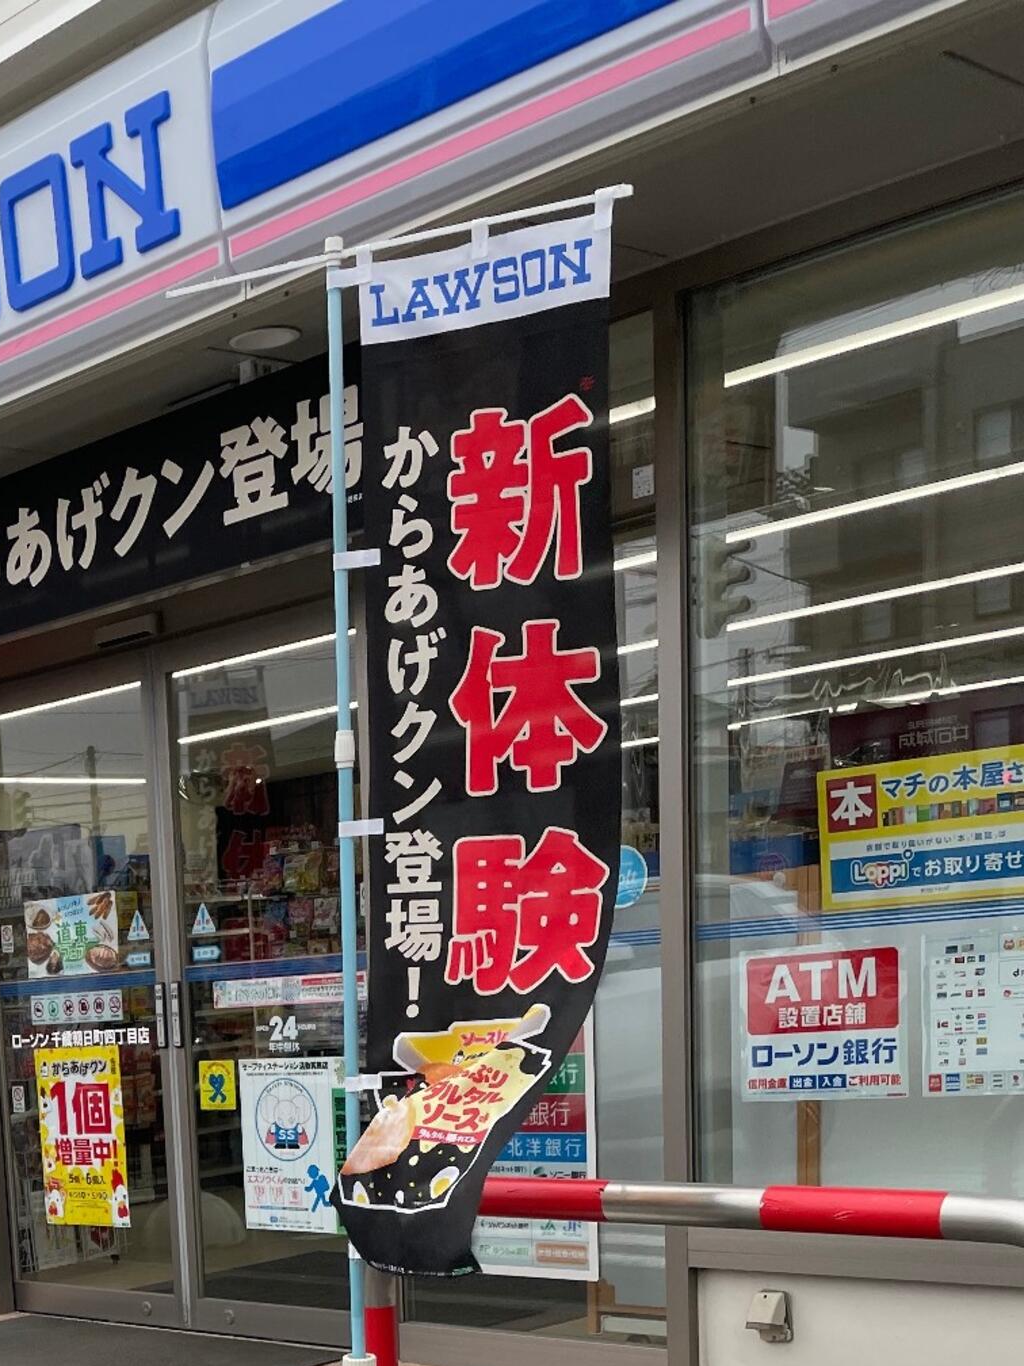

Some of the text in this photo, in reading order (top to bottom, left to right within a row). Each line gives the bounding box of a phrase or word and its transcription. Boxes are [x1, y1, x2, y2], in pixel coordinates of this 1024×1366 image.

[369, 238, 593, 327] LAWSON
[447, 393, 610, 995] 新体験
[383, 426, 446, 1018] からあげクン登場!
[831, 782, 873, 826] 本
[764, 957, 877, 1004] ATM
[269, 1016, 298, 1041] 24
[779, 1003, 867, 1028] 設置店舗
[751, 1037, 897, 1068] ローソン銀行
[52, 1060, 107, 1077] からあげクン
[748, 1074, 901, 1089] 信用金庫 出金 入金 ご利用可能
[50, 1082, 112, 1135] 1個
[278, 1130, 296, 1140] SS
[507, 1138, 582, 1158] 北洋銀行
[55, 1138, 118, 1167] 増量中!
